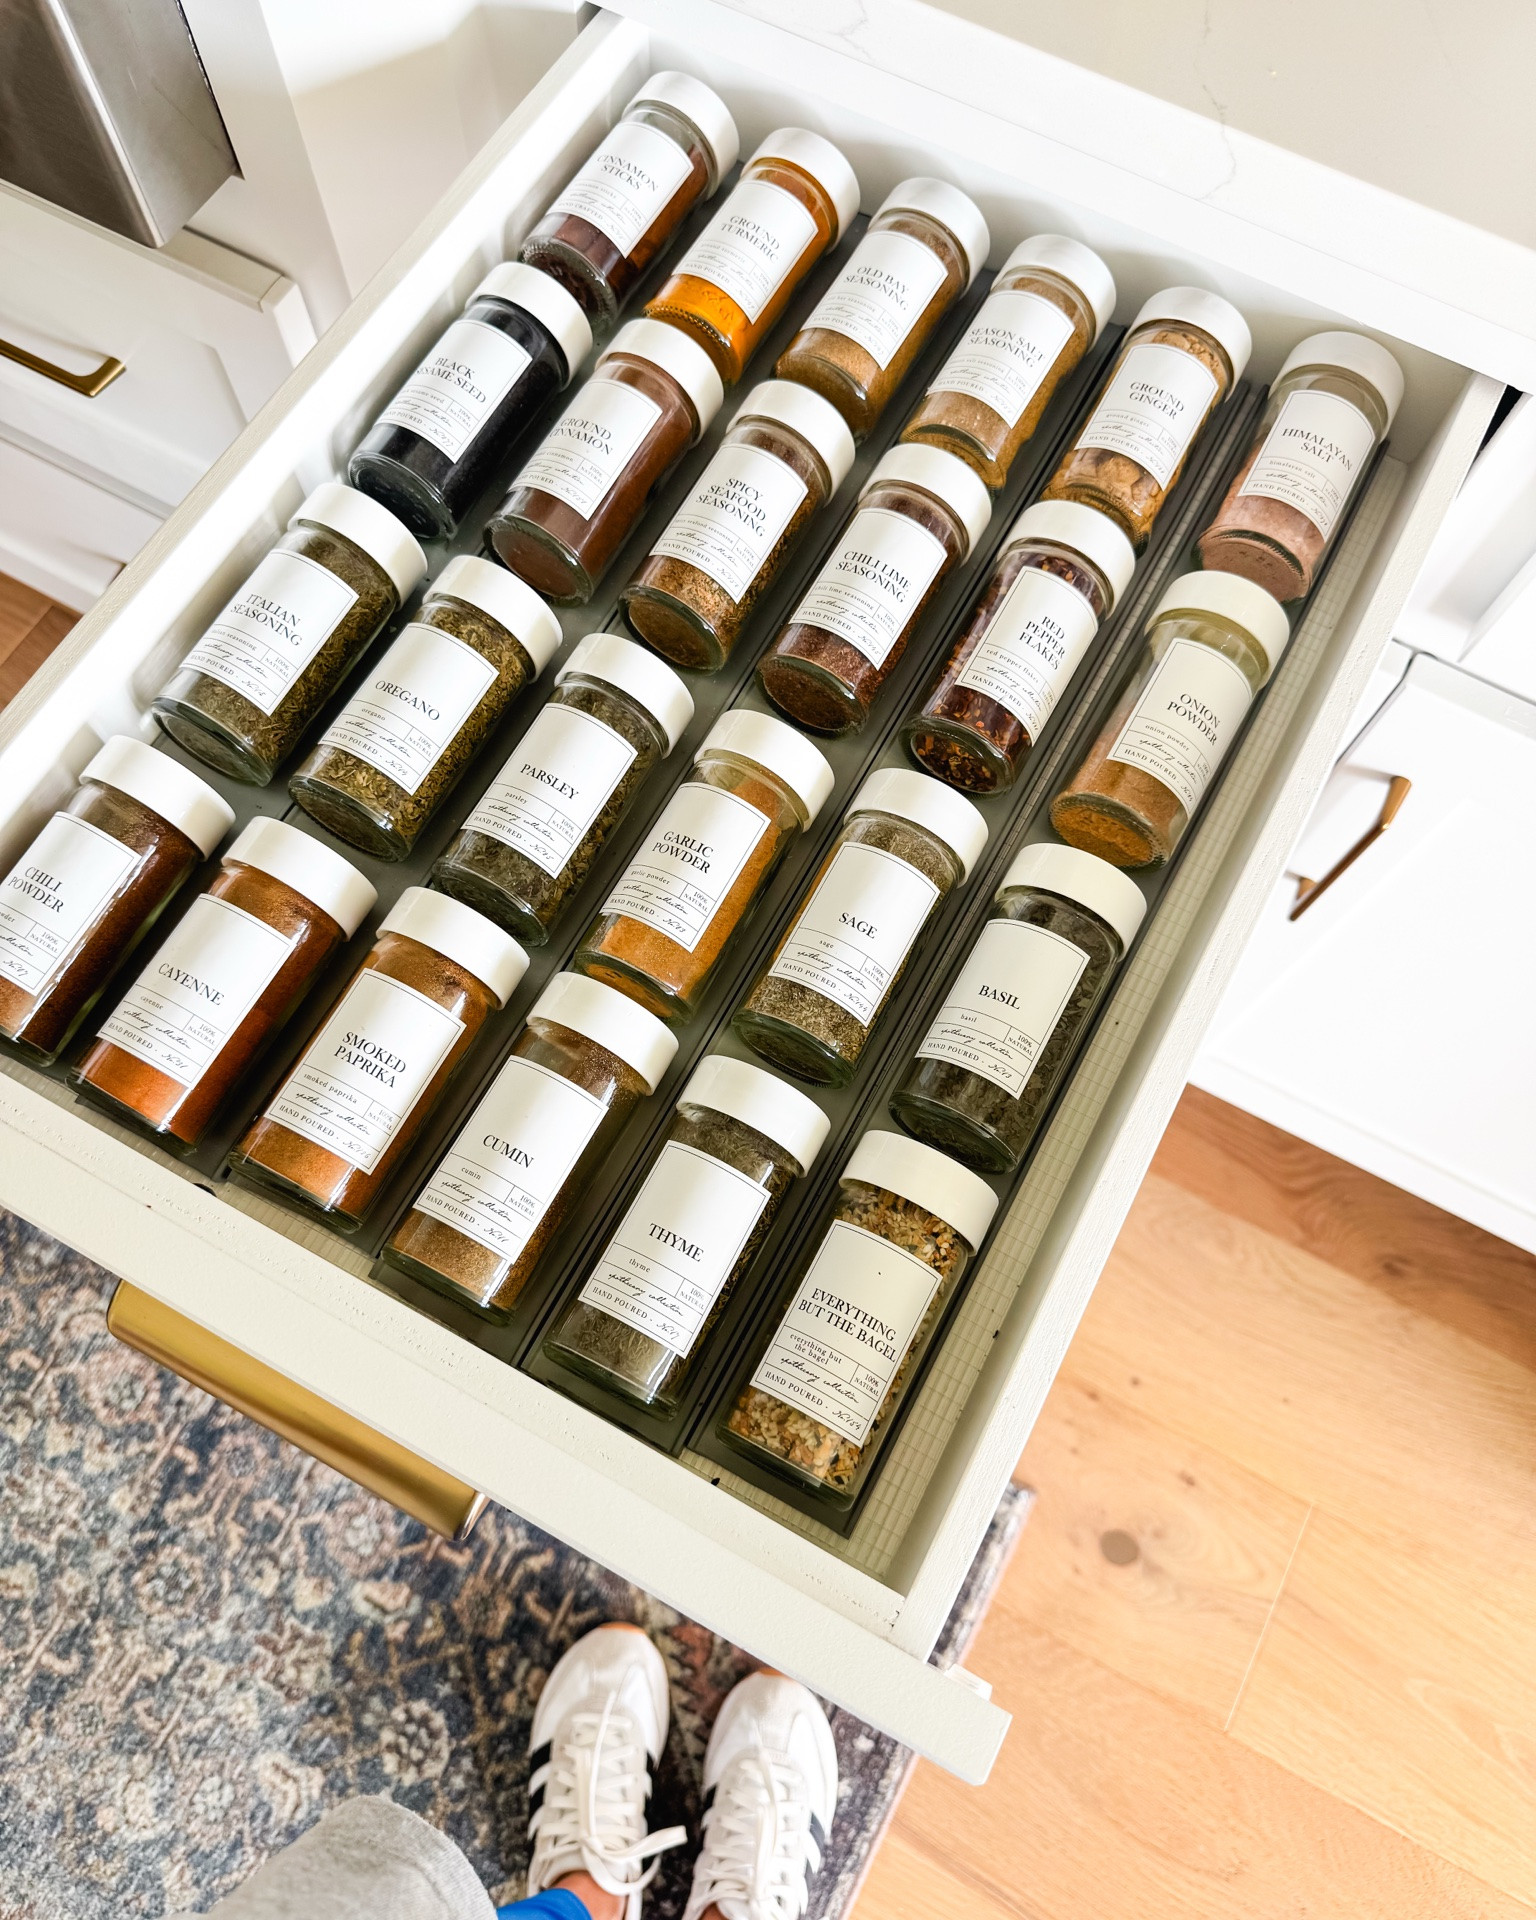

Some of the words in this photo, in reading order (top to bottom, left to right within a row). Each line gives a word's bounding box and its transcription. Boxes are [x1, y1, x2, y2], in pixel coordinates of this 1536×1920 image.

[601, 164, 640, 190] STICKS
[720, 223, 779, 262] TURMERIC
[730, 215, 780, 250] GROUND
[843, 275, 909, 310] SEASONING
[857, 267, 883, 279] OLD
[885, 274, 909, 294] BAY
[966, 336, 1035, 368] SEASONING
[968, 327, 1016, 341] SEASON
[1016, 337, 1045, 361] SALT
[435, 357, 475, 380] BLACK
[417, 366, 455, 382] ESAME
[454, 377, 486, 403] SEED
[1130, 381, 1184, 412] GROUND
[1129, 391, 1177, 420] GINGER
[560, 418, 611, 440] GROUND
[1281, 428, 1353, 471] HIMALAYAN
[1300, 441, 1333, 463] SALT
[726, 478, 763, 501] SPICY
[695, 494, 766, 537] SEASONING
[707, 485, 766, 521] SEAFOOD
[681, 545, 710, 563] POURED
[835, 561, 906, 603] SEASONING
[844, 551, 880, 569] CHILI
[881, 564, 911, 592] LIME
[246, 594, 301, 627] ITALIAN
[822, 613, 852, 631] POURED
[230, 604, 302, 646] SEASONING
[1041, 616, 1065, 639] RED
[227, 633, 257, 652] seasoning
[1019, 631, 1060, 670] FLAKES
[1025, 621, 1065, 659] PEPPER
[206, 658, 234, 676] POURED
[265, 657, 289, 678] NATURAL
[275, 656, 290, 671] 100%
[986, 649, 998, 657] red
[999, 654, 1022, 669] pepper
[375, 680, 440, 721] OREGANO
[972, 674, 994, 687] HAND
[995, 685, 1021, 707] POURED
[361, 708, 386, 721] oregano
[1167, 701, 1217, 746] POWDER
[1180, 693, 1220, 729] ONION
[348, 737, 378, 755] POURED
[1145, 724, 1165, 736] onion
[1166, 734, 1189, 751] powder
[1124, 749, 1148, 760] HAND
[1149, 758, 1177, 780] POURED
[520, 763, 579, 799] PARSLEY
[504, 791, 528, 804] parsley
[473, 816, 492, 825] HAND
[492, 822, 522, 840] POURED
[663, 830, 714, 858] GARLIC
[652, 842, 711, 874] POWDER
[25, 866, 62, 892] CHILI
[646, 873, 670, 885] powder
[8, 876, 64, 913] POWDER
[683, 893, 708, 912] NATURAL
[693, 891, 708, 904] 100%
[0, 910, 15, 923] wder
[626, 900, 655, 916] POURED
[42, 931, 58, 946] 100%
[838, 912, 878, 939] SAGE
[31, 933, 58, 953] NATURAL
[819, 940, 834, 949] sage
[158, 962, 225, 1006] CAYENNE
[782, 962, 803, 973] HAND
[804, 969, 837, 989] POURED
[140, 995, 164, 1010] cayenne
[978, 984, 1020, 1010] BASIL
[199, 1023, 216, 1038] 100%
[960, 1014, 978, 1023] basil
[123, 1029, 153, 1049] POURED
[188, 1025, 215, 1045] NATURAL
[1007, 1037, 1033, 1056] NATURAL
[1017, 1034, 1032, 1048] 100%
[341, 1031, 406, 1073] SMOKED
[927, 1042, 946, 1050] HAND
[947, 1045, 979, 1061] POURED
[333, 1045, 396, 1089] PAPRIKA
[303, 1073, 328, 1088] smoked
[328, 1085, 357, 1104] paprika
[279, 1104, 299, 1118] HAND
[300, 1114, 335, 1137] POURED
[368, 1112, 392, 1131] NATURAL
[483, 1134, 534, 1168] CUMIN
[461, 1167, 481, 1181] cumin
[425, 1193, 443, 1206] HAND
[443, 1203, 476, 1224] POURED
[509, 1197, 535, 1217] NATURAL
[520, 1195, 536, 1208] 100%
[648, 1222, 704, 1262] THYME
[628, 1258, 651, 1273] thyme
[592, 1286, 613, 1301] HAND
[614, 1297, 648, 1319] POURED
[680, 1291, 704, 1310] NATURAL
[811, 1287, 897, 1342] EVERYTHING
[798, 1299, 826, 1319] BUT
[826, 1311, 856, 1337] THE
[856, 1328, 897, 1363] BAGEL
[789, 1333, 827, 1358] everything
[828, 1351, 842, 1365] but
[794, 1343, 805, 1353] the
[808, 1349, 829, 1366] bagel
[765, 1371, 787, 1386] HAND
[788, 1382, 823, 1406] POURED
[854, 1377, 880, 1397] NATURAL
[864, 1374, 880, 1388] 100%
